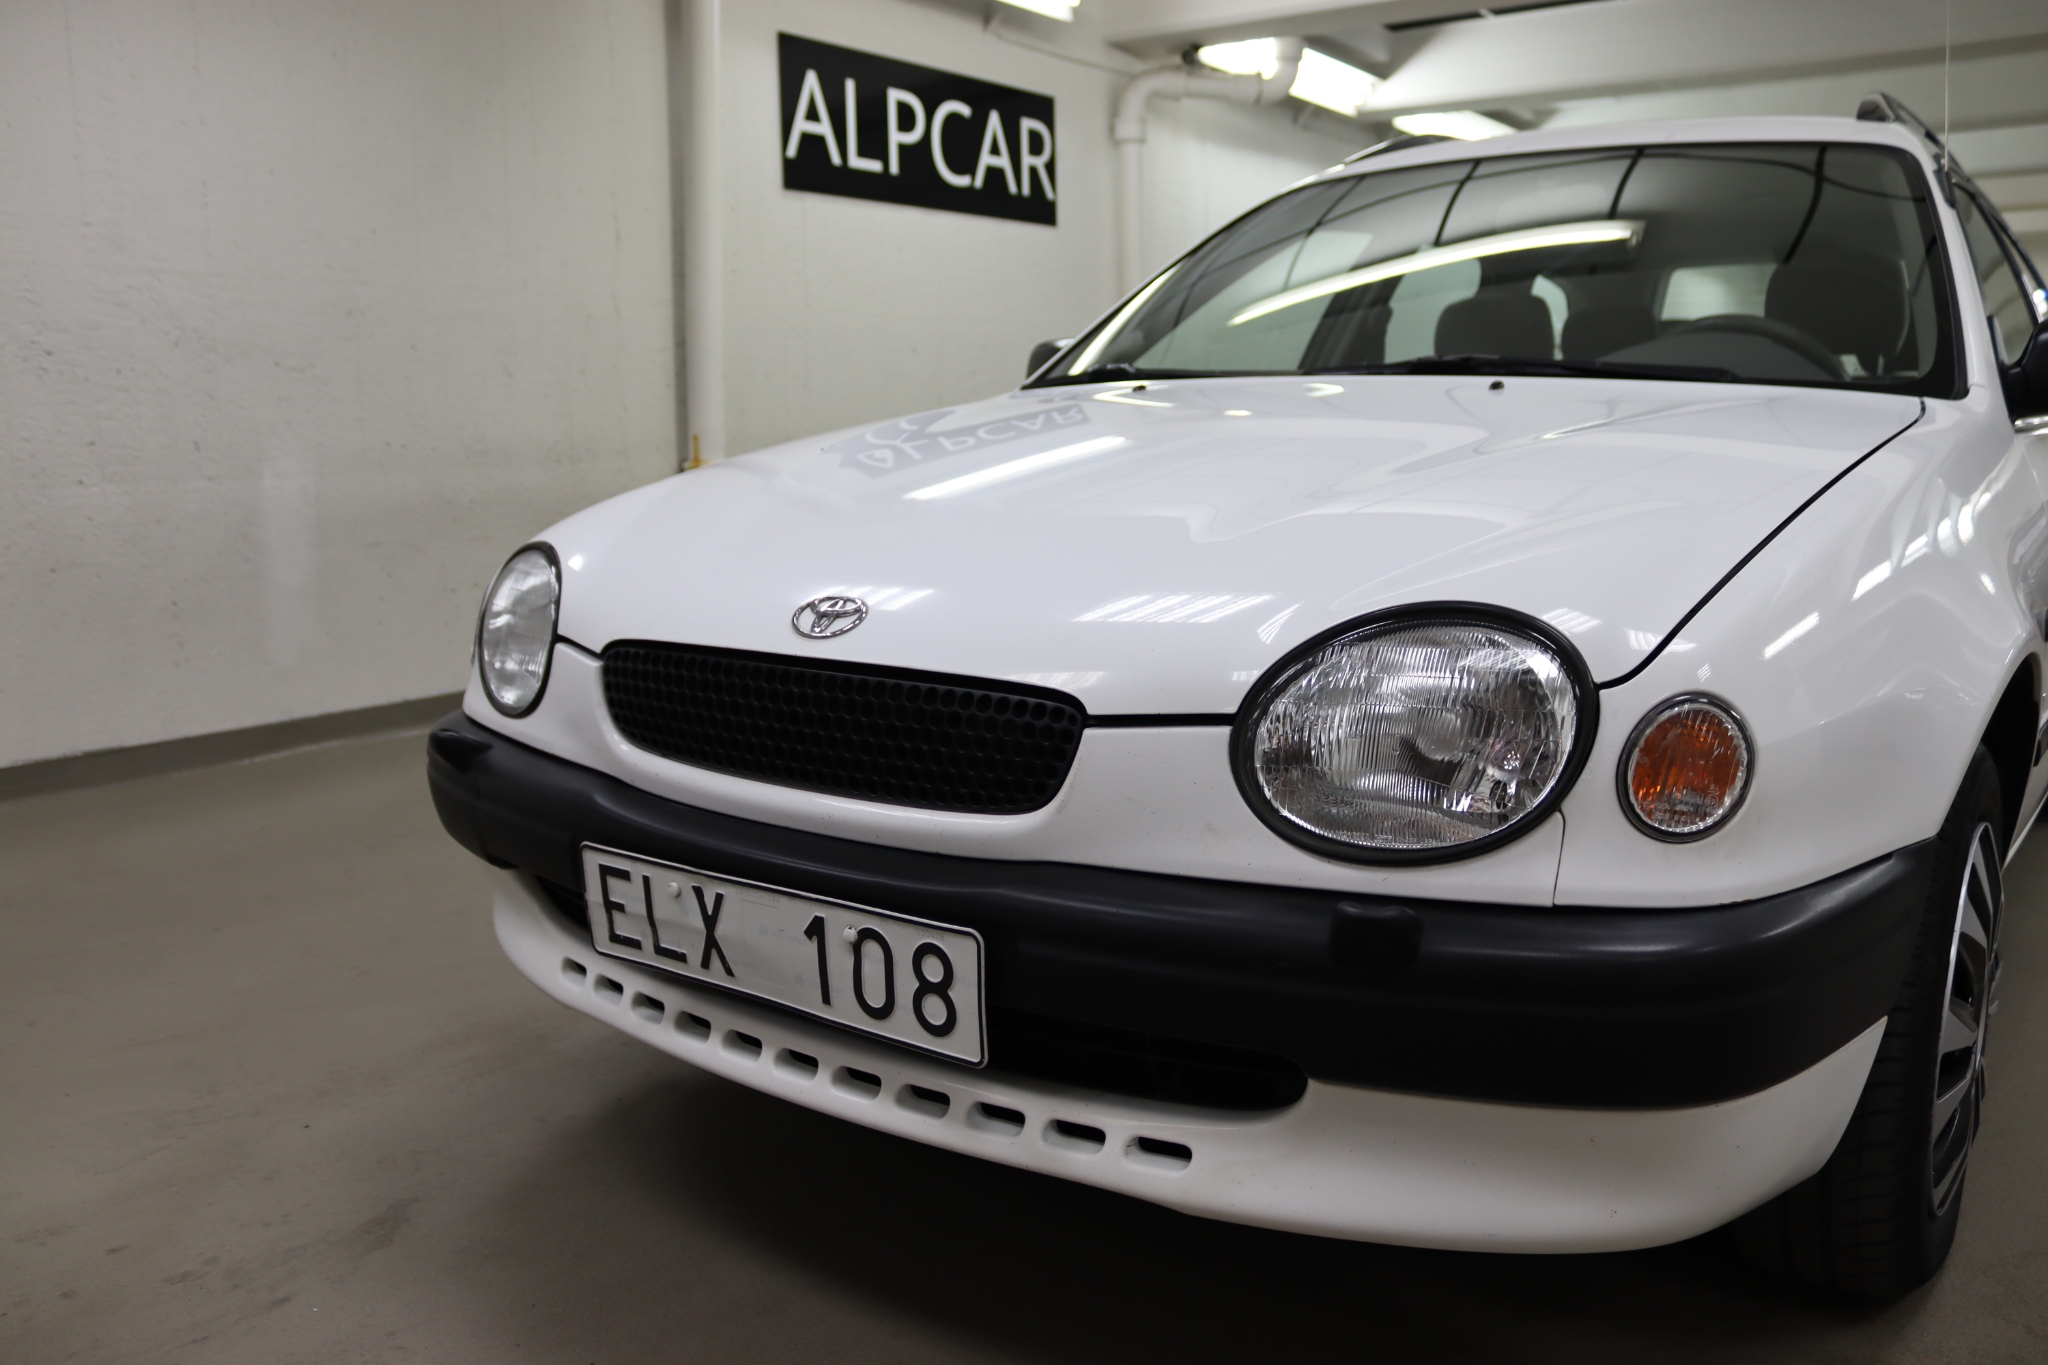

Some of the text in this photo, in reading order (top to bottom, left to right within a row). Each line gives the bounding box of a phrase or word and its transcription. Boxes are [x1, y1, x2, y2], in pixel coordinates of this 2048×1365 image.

[786, 68, 1056, 201] ALPCAR
[598, 863, 957, 1038] ELX 108
